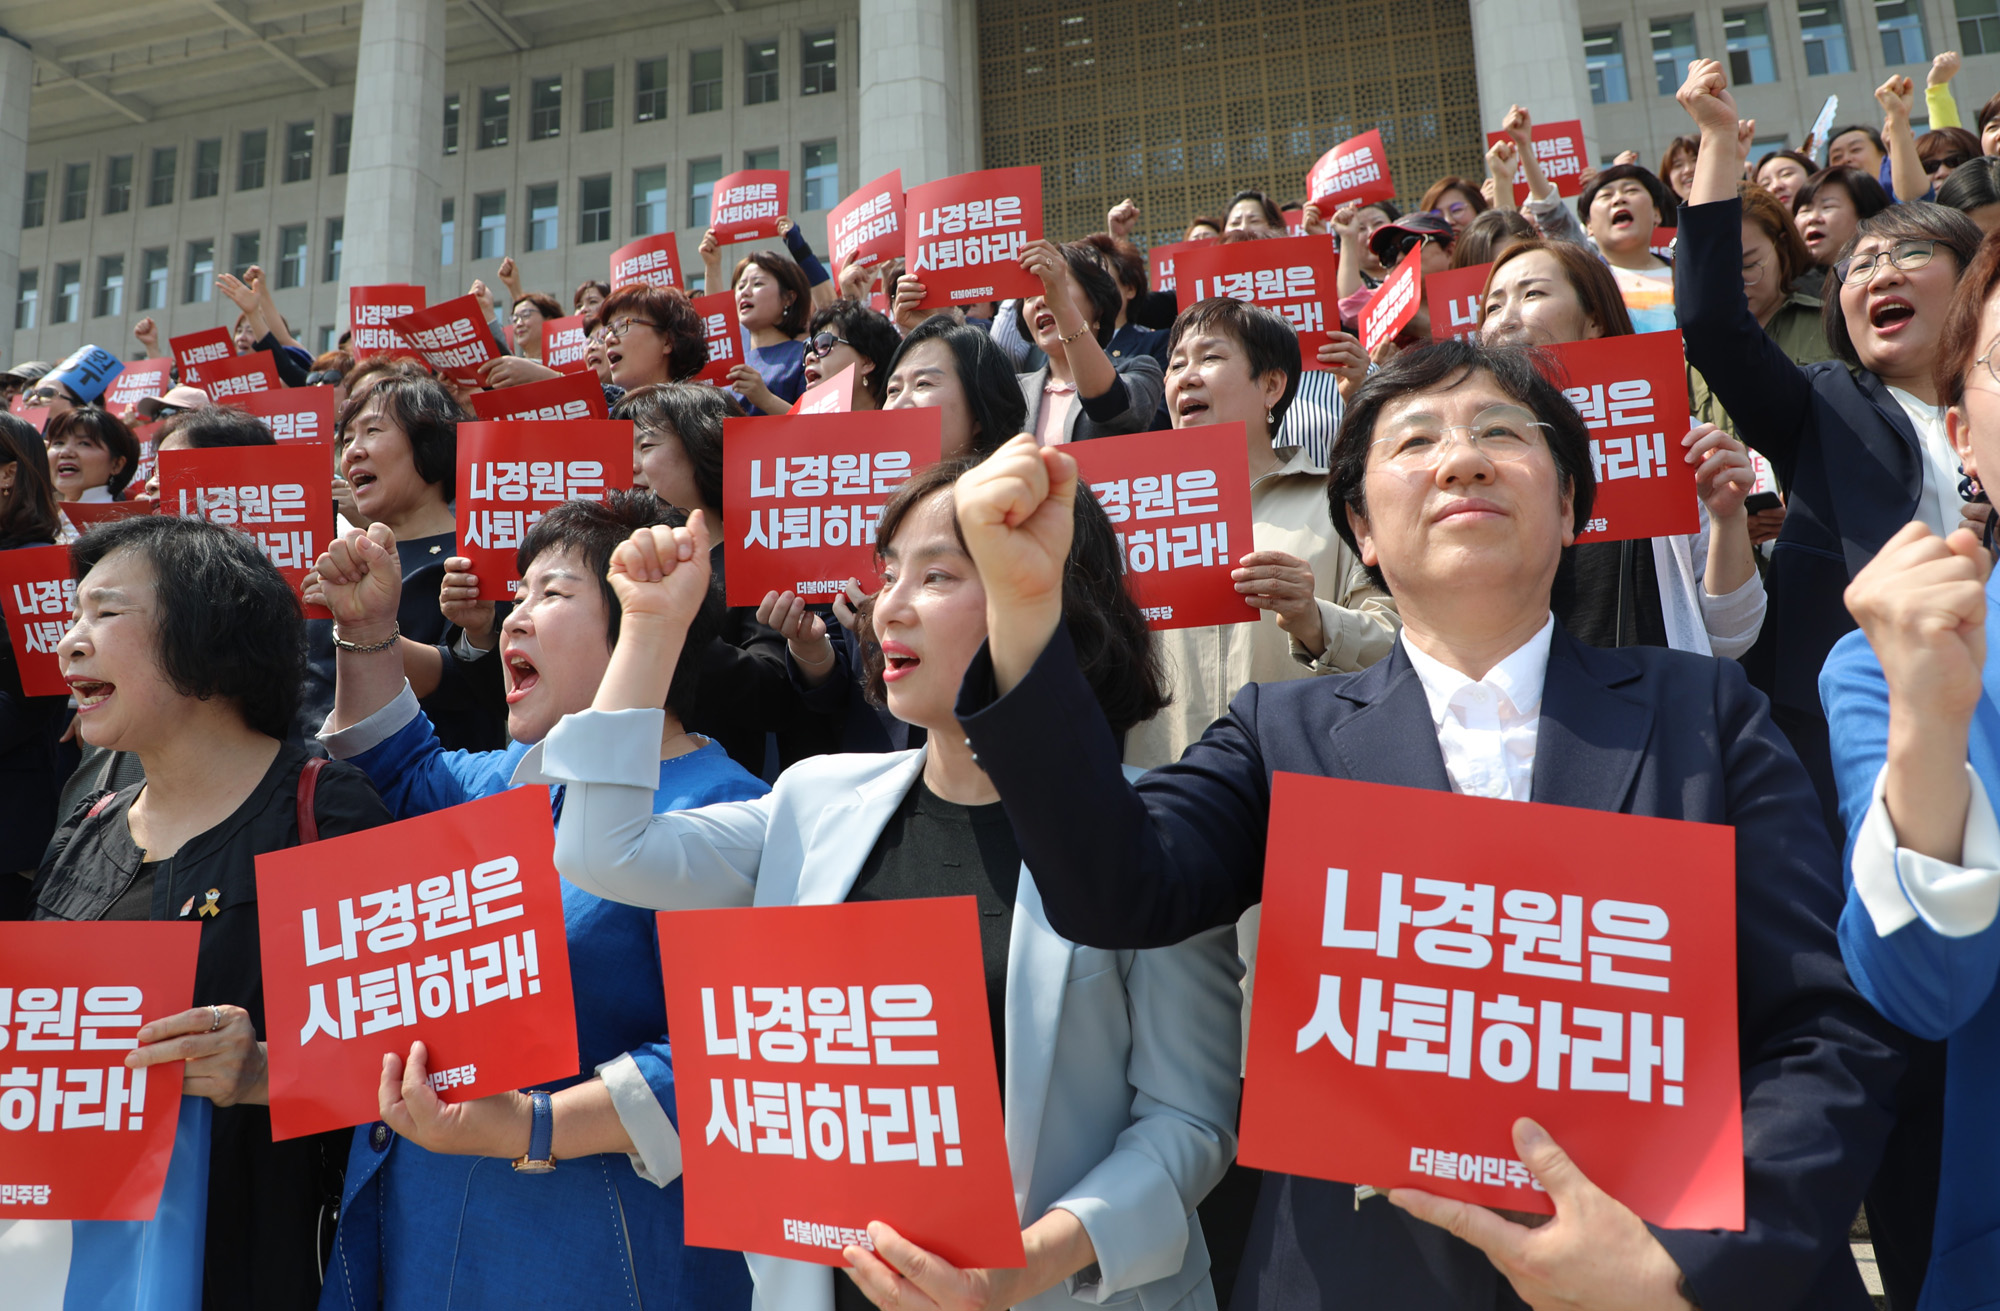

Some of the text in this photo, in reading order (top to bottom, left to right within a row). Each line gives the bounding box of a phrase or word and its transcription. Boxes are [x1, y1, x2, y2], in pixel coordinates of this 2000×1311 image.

[714, 201, 779, 226] 사퇴하라!
[718, 183, 777, 207] 나경원은
[834, 191, 892, 241] 나경원은
[918, 196, 1022, 238] 나경원은
[834, 211, 898, 263] 사퇴하라!
[615, 249, 669, 280] 나경원은
[950, 286, 994, 300] 더불어민주당
[355, 328, 412, 349] 사퇴하
[405, 317, 476, 349] 나경원은
[181, 342, 230, 366] 나경원은
[548, 344, 583, 367] 사퇴하
[208, 371, 268, 401] 나경원은
[1562, 379, 1654, 430] 원은
[258, 411, 318, 440] 원은
[470, 461, 604, 501] 나경원은
[750, 451, 912, 498] 나경원은
[179, 483, 305, 525] 나경원은
[1090, 469, 1219, 523] 경원은
[744, 504, 888, 550] 사퇴하
[1115, 521, 1229, 575] 하라!
[796, 579, 861, 595] 더불어민주
[1139, 605, 1173, 621] 민주당
[302, 856, 524, 967] 나경원은
[1321, 867, 1672, 993] 나경원은
[300, 929, 541, 1046] 사퇴하라!
[701, 984, 940, 1065] 나경원은
[1296, 974, 1685, 1106] 사퇴하라!
[425, 1063, 477, 1092] 민주당
[705, 1078, 963, 1166] 사퇴하라!
[0, 1184, 51, 1206] 민주당
